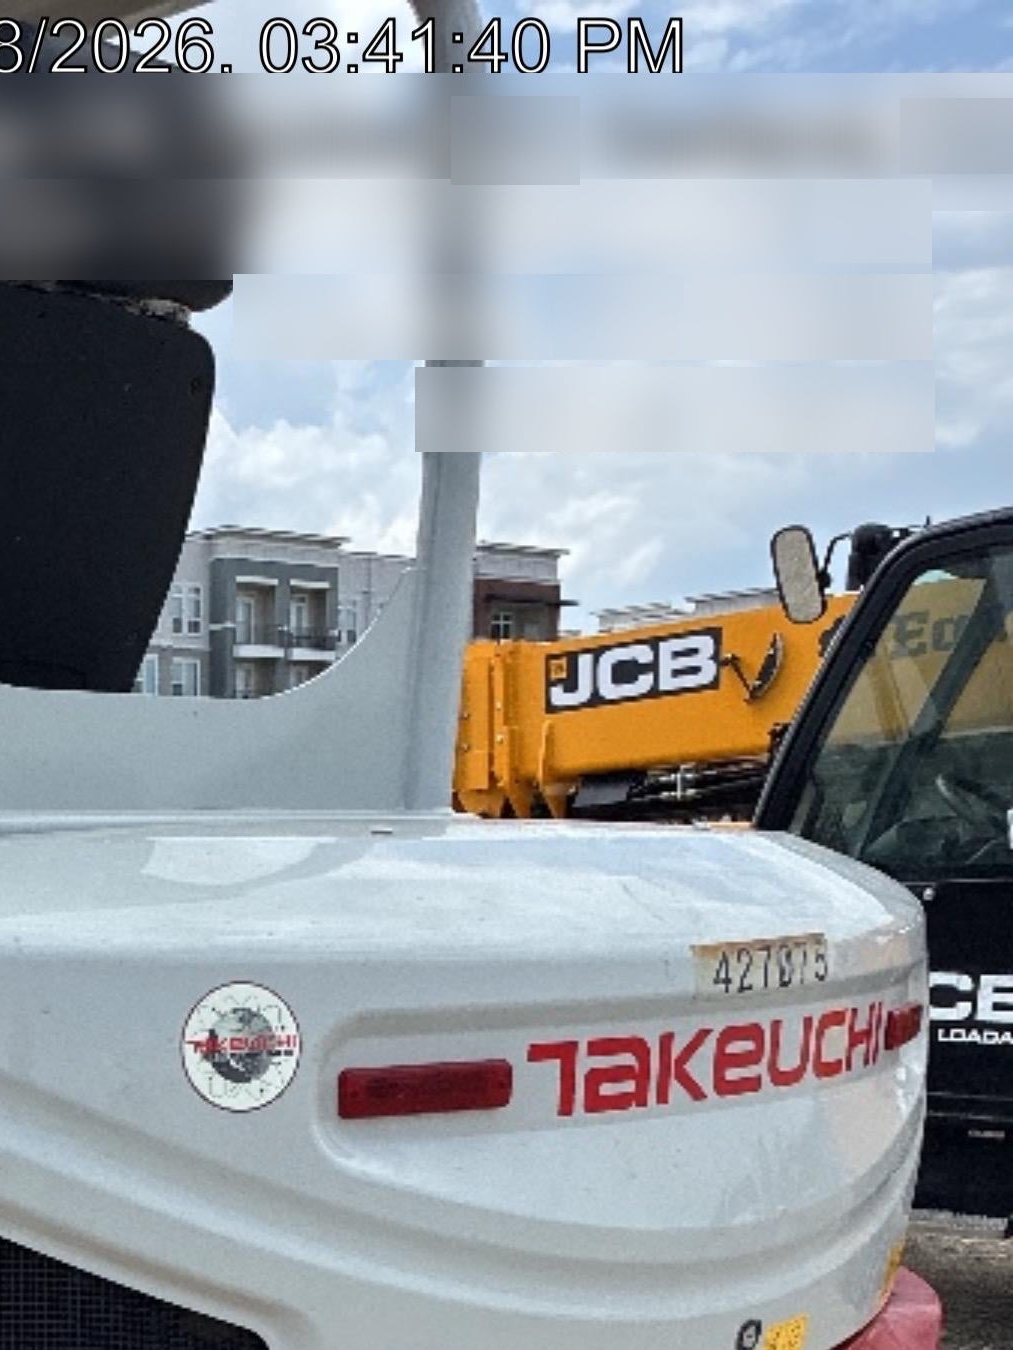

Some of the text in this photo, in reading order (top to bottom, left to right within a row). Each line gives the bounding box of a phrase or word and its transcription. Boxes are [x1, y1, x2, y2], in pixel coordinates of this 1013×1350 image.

[550, 635, 718, 706] JCB
[713, 941, 828, 993] 427075
[527, 1001, 883, 1116] TAKEUCHI
